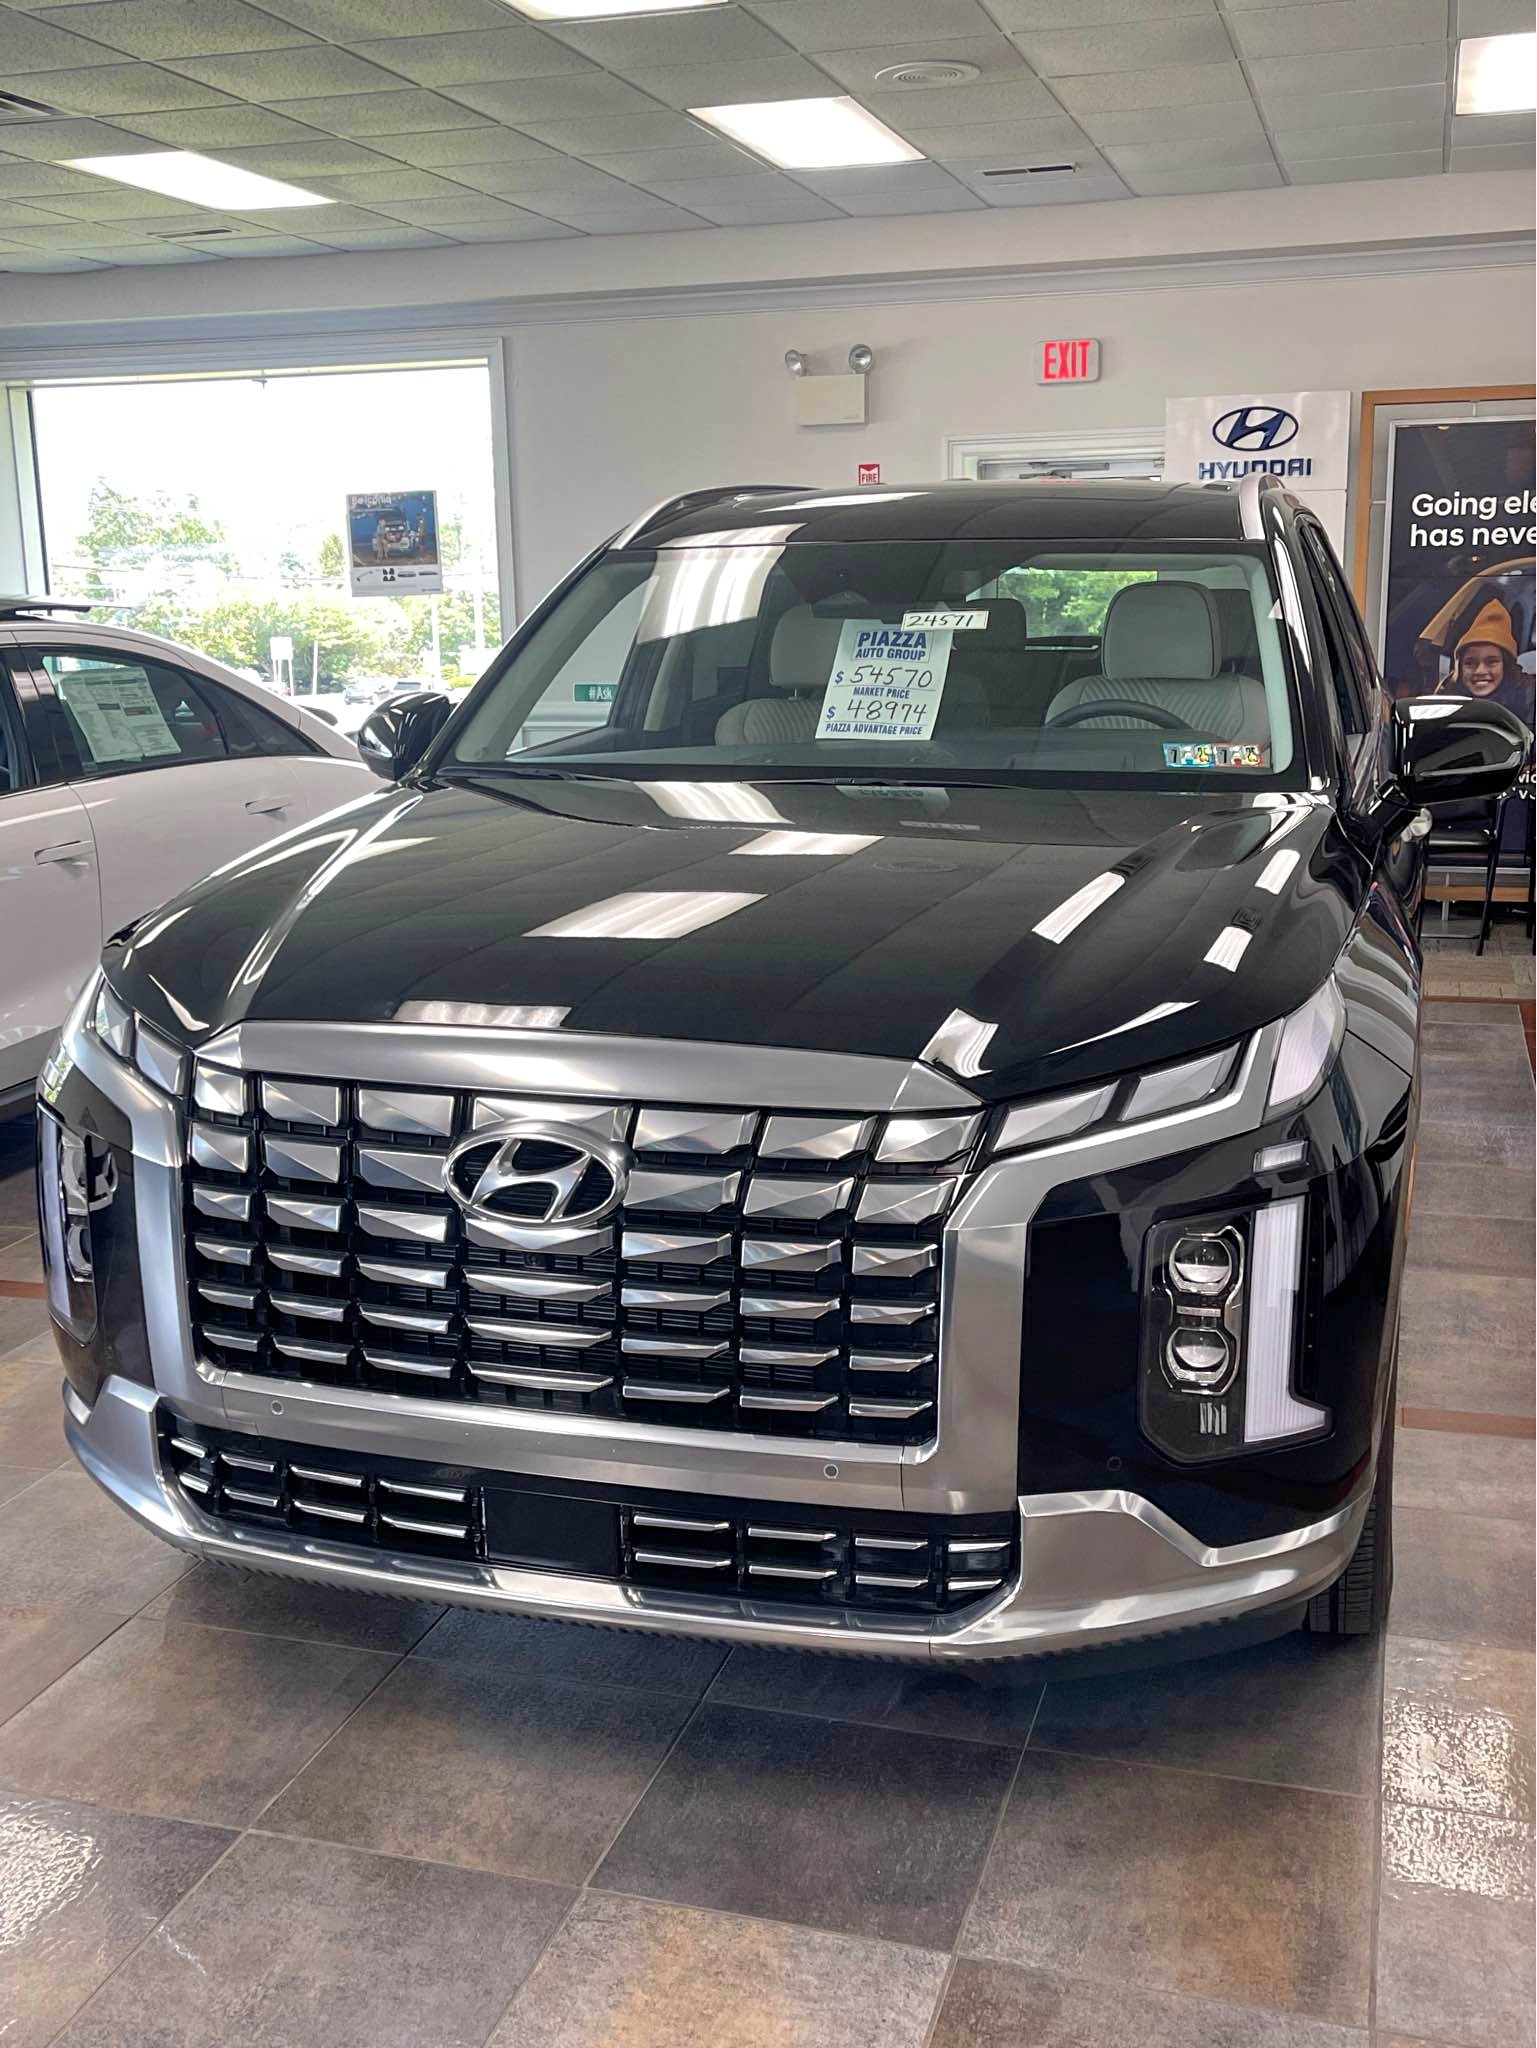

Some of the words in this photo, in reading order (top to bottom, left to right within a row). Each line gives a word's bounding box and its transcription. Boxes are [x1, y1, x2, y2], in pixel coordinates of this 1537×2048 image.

[1043, 341, 1090, 379] EXIT
[862, 474, 877, 483] FIRE
[1199, 458, 1312, 480] HYUNDAI
[1411, 490, 1498, 520] Going
[1410, 523, 1464, 547] has
[906, 614, 974, 628] 24571
[857, 631, 927, 649] PIAZZA
[855, 647, 885, 659] AUTO
[887, 648, 926, 661] GROUP
[850, 665, 933, 688] 54570
[853, 686, 884, 698] MARKET
[886, 689, 910, 700] PRICE
[847, 699, 927, 724] 48974
[825, 723, 851, 733] PIAZZA
[852, 725, 898, 735] ADVANTAGE
[899, 727, 923, 736] PRICE
